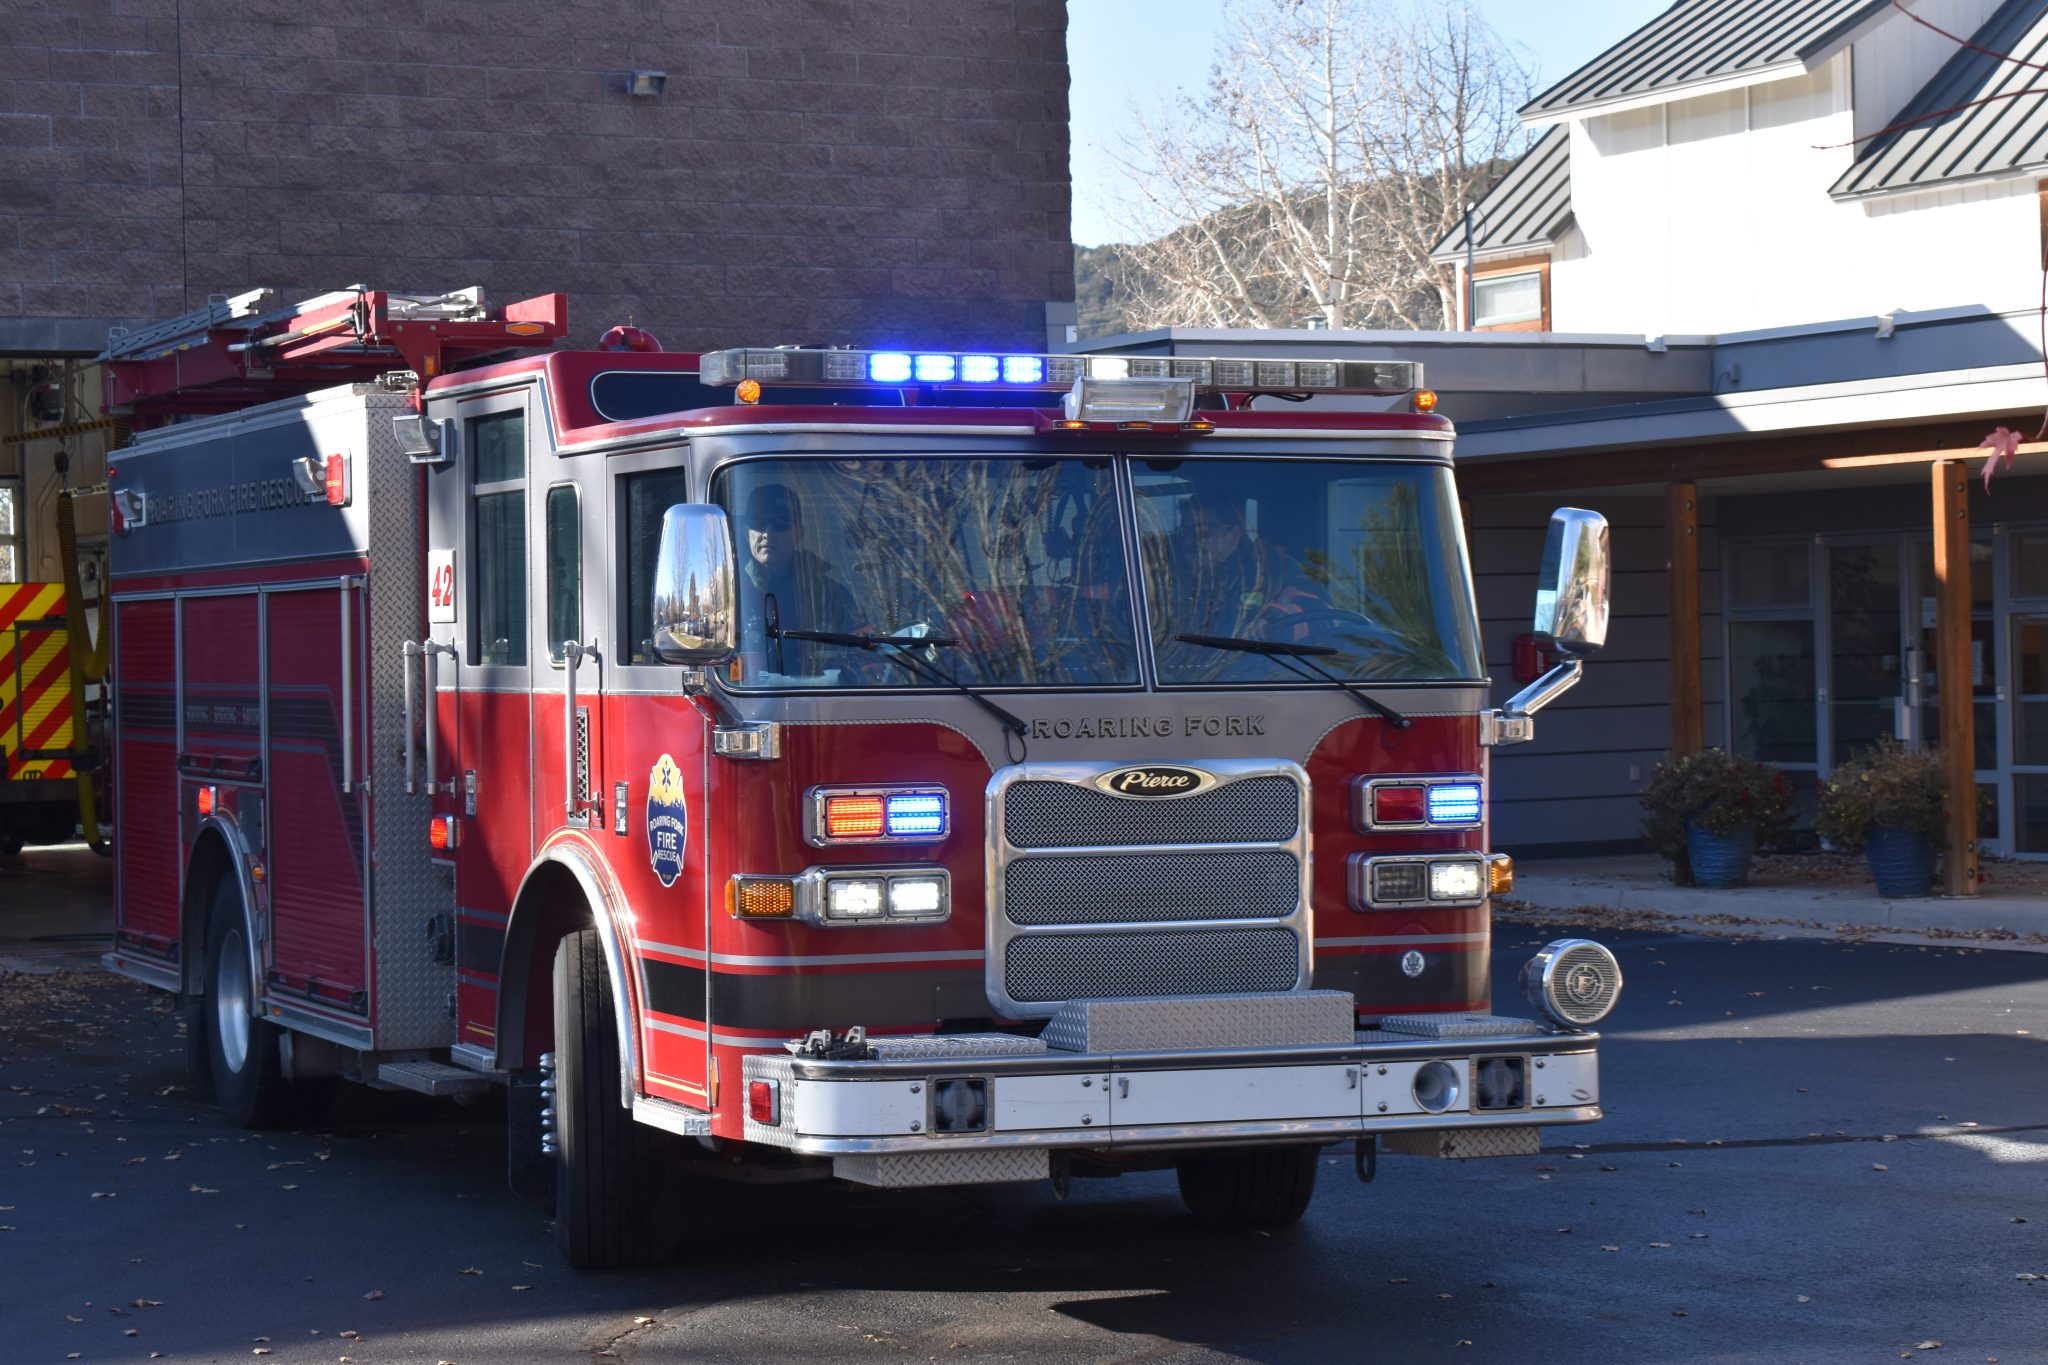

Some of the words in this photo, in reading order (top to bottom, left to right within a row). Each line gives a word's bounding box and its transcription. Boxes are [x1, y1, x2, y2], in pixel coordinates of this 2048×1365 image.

[147, 492, 193, 524] ROARING
[196, 489, 226, 517] FORK
[229, 483, 256, 514] FIRE
[431, 564, 453, 607] 42
[1032, 718, 1173, 739] ROARING
[1185, 715, 1265, 737] FORK
[1119, 770, 1191, 792] Pierce
[650, 816, 670, 831] ROARING
[671, 817, 684, 836] FORK
[657, 831, 677, 850] FIRE
[657, 850, 676, 861] RESCUE
